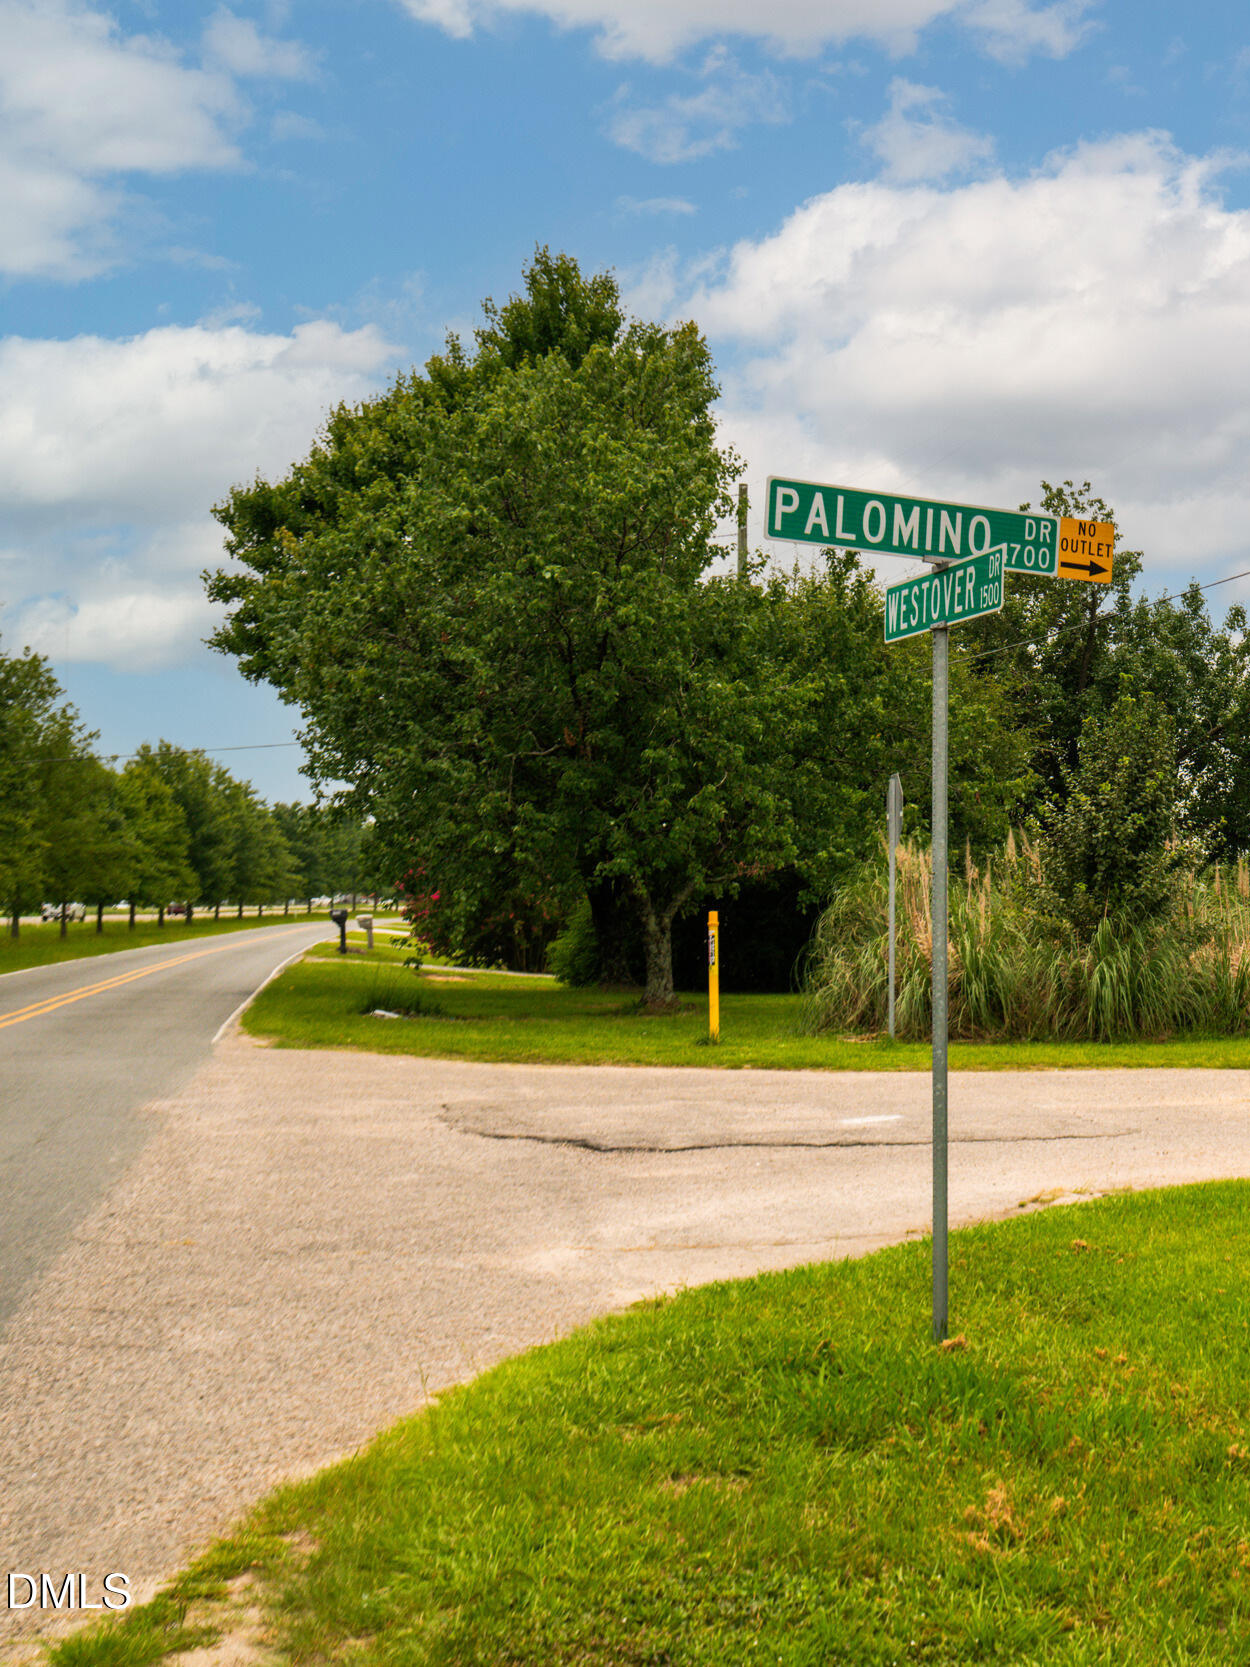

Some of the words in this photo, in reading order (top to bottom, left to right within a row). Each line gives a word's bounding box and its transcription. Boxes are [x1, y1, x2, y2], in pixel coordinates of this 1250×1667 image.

[774, 486, 991, 556] PALOMINO
[1024, 518, 1052, 543] DR
[1078, 522, 1096, 537] NO
[1060, 537, 1112, 558] OUTLET
[888, 565, 976, 634] WESTOVER
[988, 553, 1000, 578] DR
[980, 581, 999, 609] 1500
